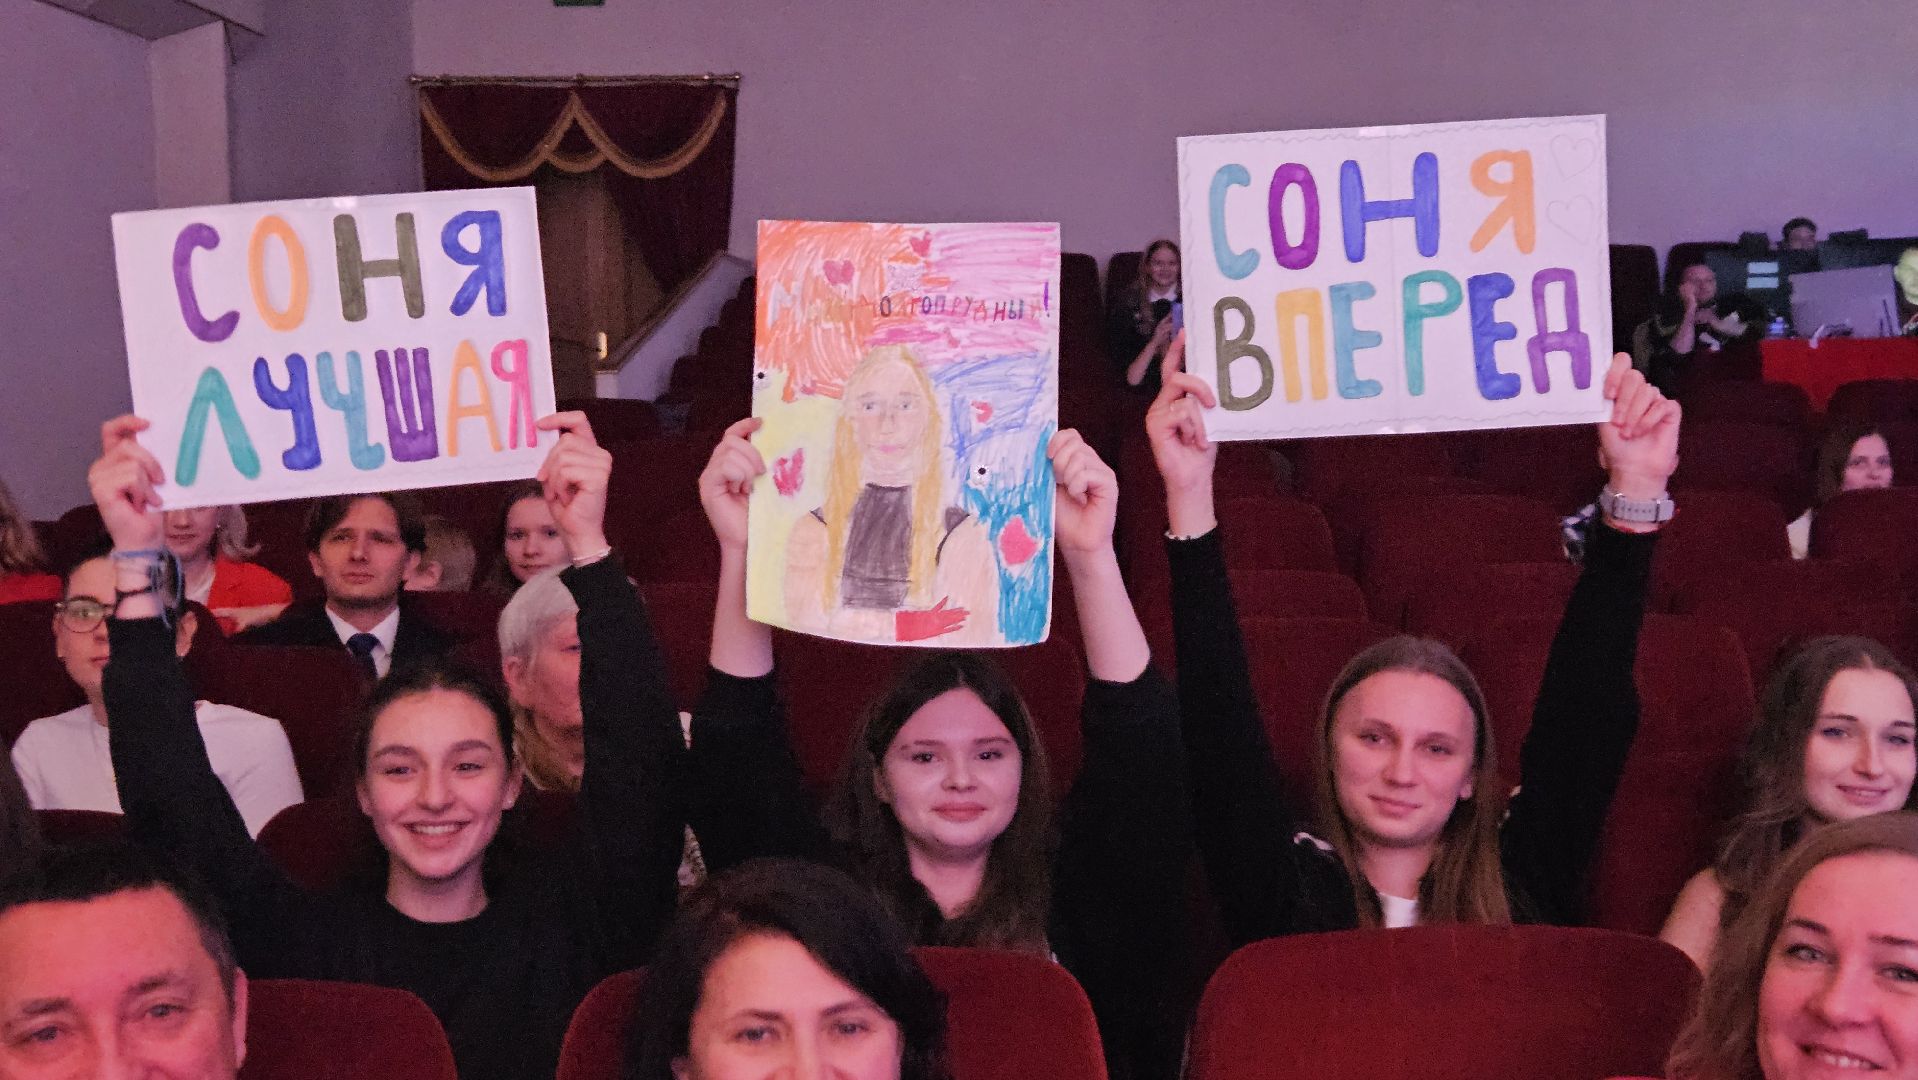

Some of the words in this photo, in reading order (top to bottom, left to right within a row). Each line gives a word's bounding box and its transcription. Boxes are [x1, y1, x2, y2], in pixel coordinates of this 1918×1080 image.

[172, 209, 507, 342] СОНЯ
[1209, 149, 1536, 280] СОНЯ
[1213, 267, 1592, 412] ВПЕРЕД
[175, 338, 538, 487] ЛУЧШАЯ
